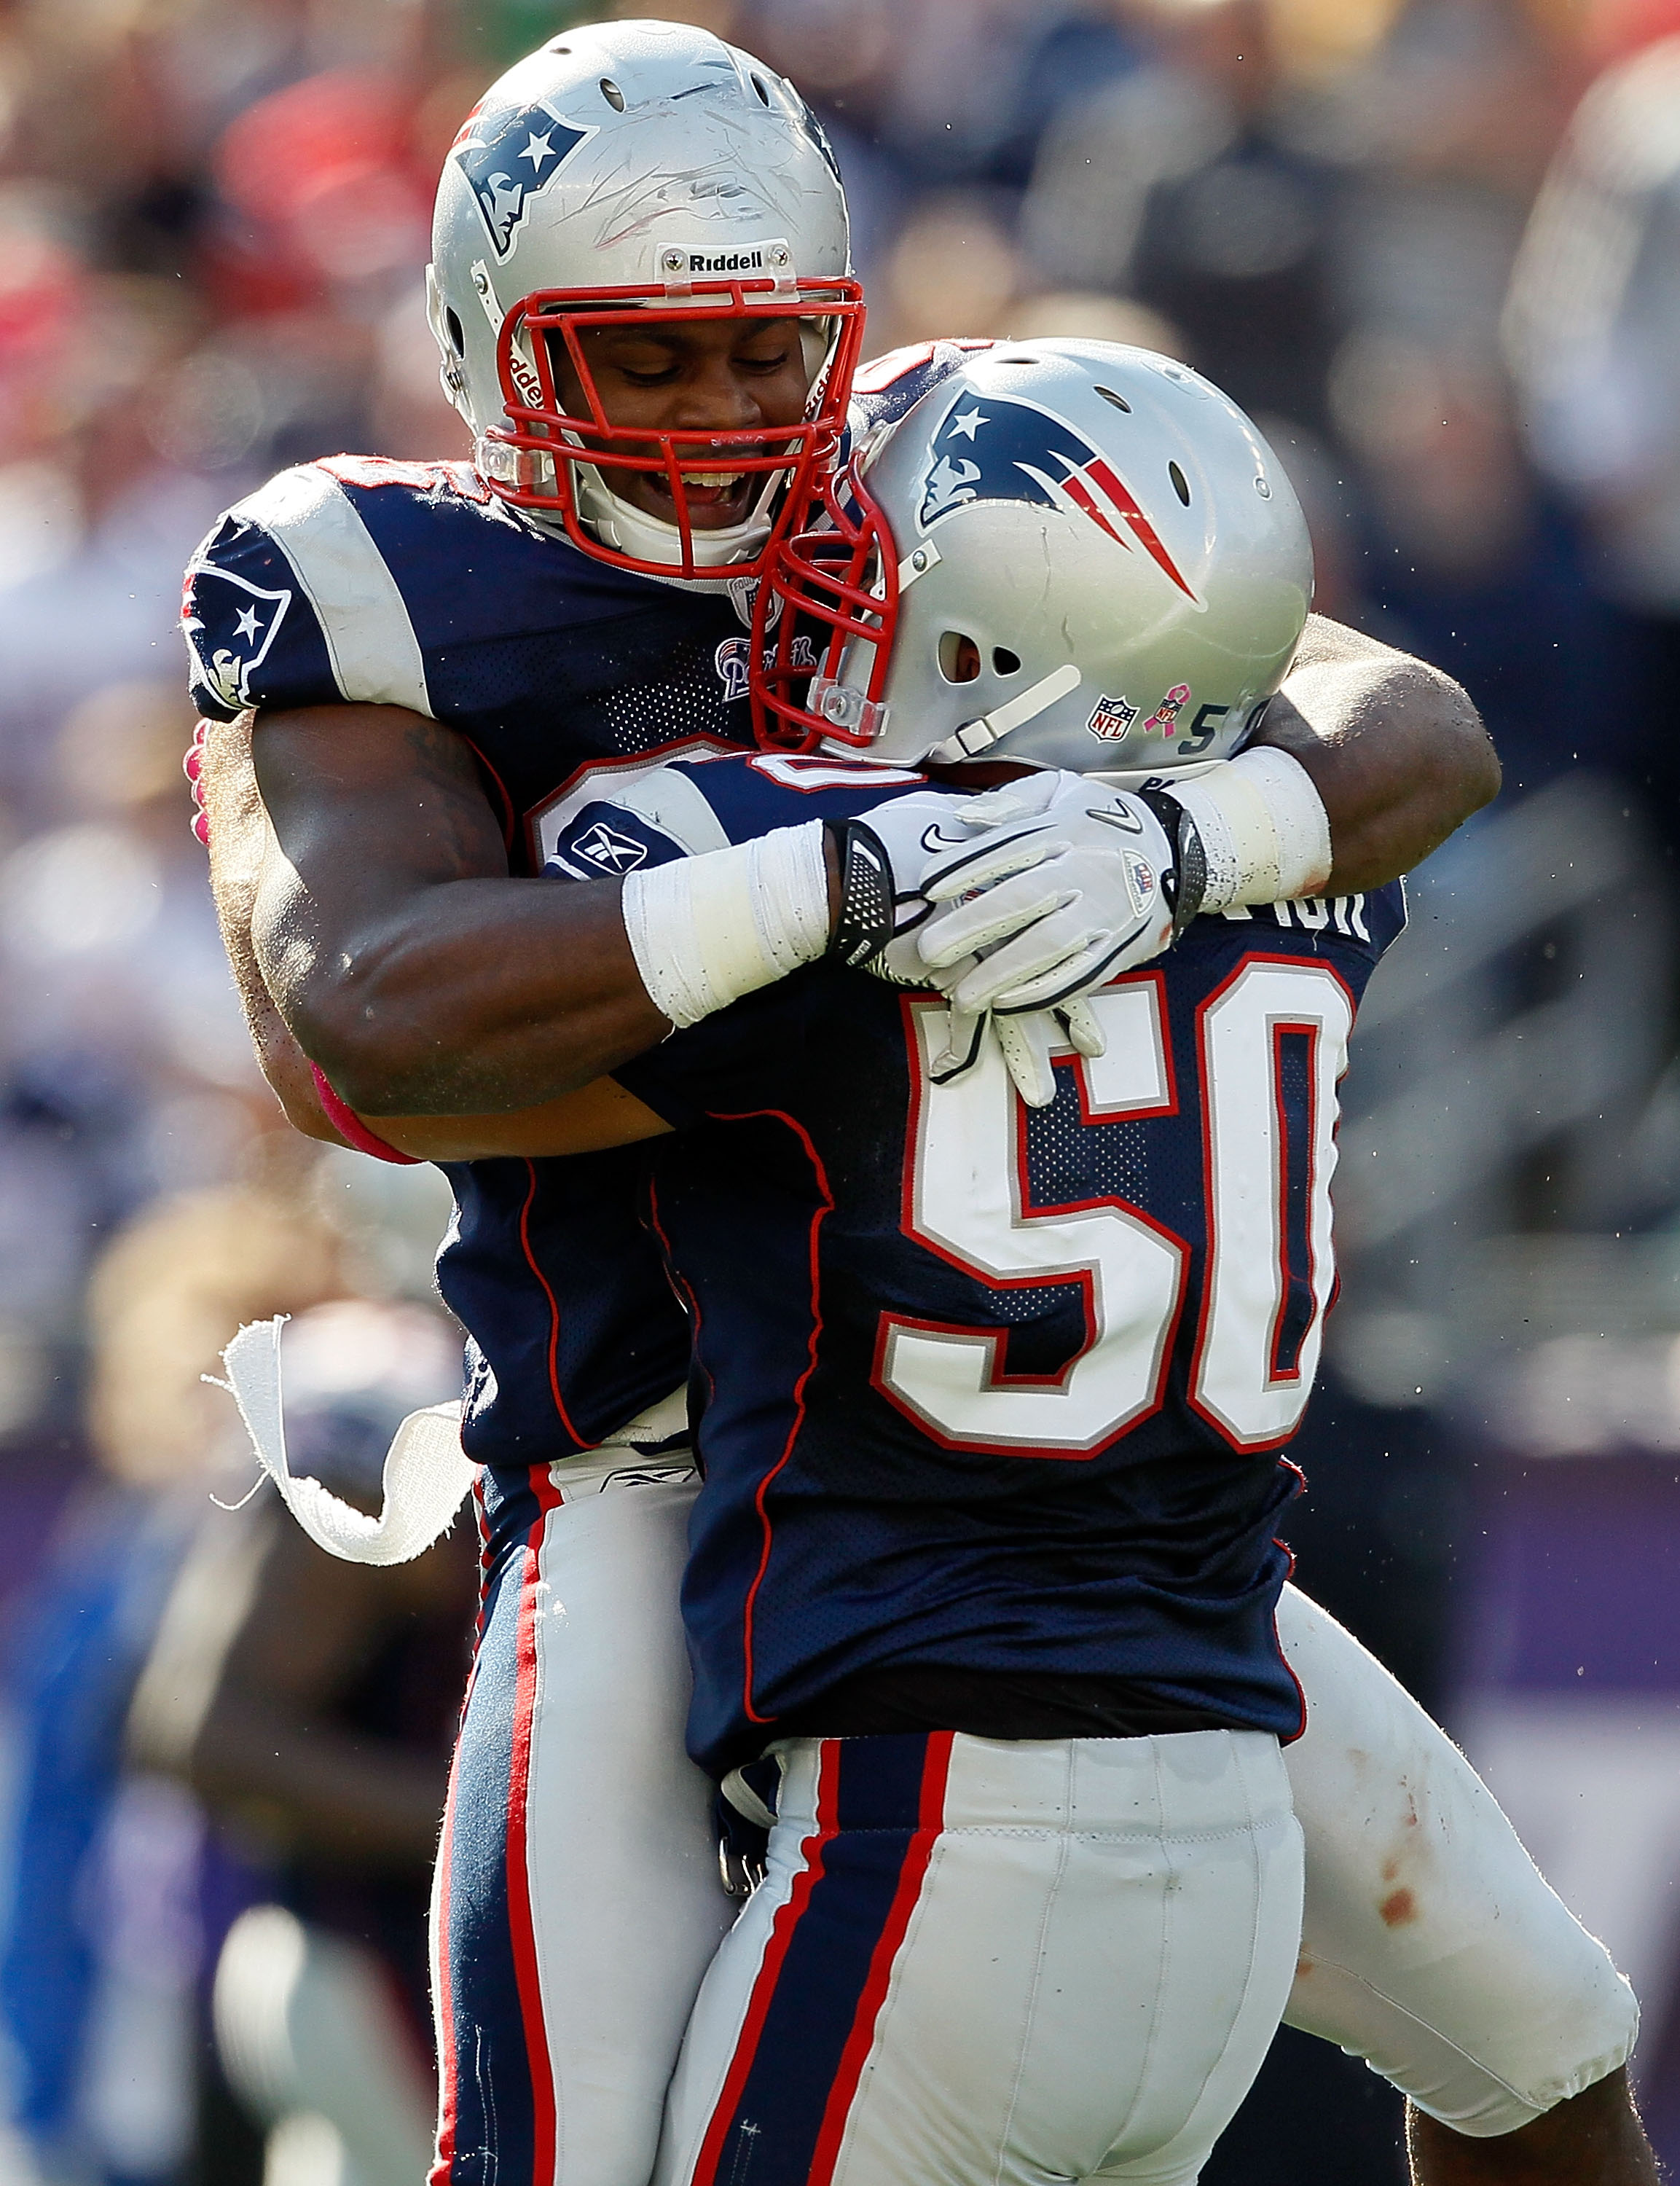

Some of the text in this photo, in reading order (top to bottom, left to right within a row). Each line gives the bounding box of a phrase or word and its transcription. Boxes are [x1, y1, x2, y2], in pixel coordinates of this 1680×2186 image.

[689, 251, 763, 271] Riddell
[1091, 712, 1125, 738] NFL
[1156, 707, 1175, 721] NFL
[871, 951, 1357, 1460] 50
